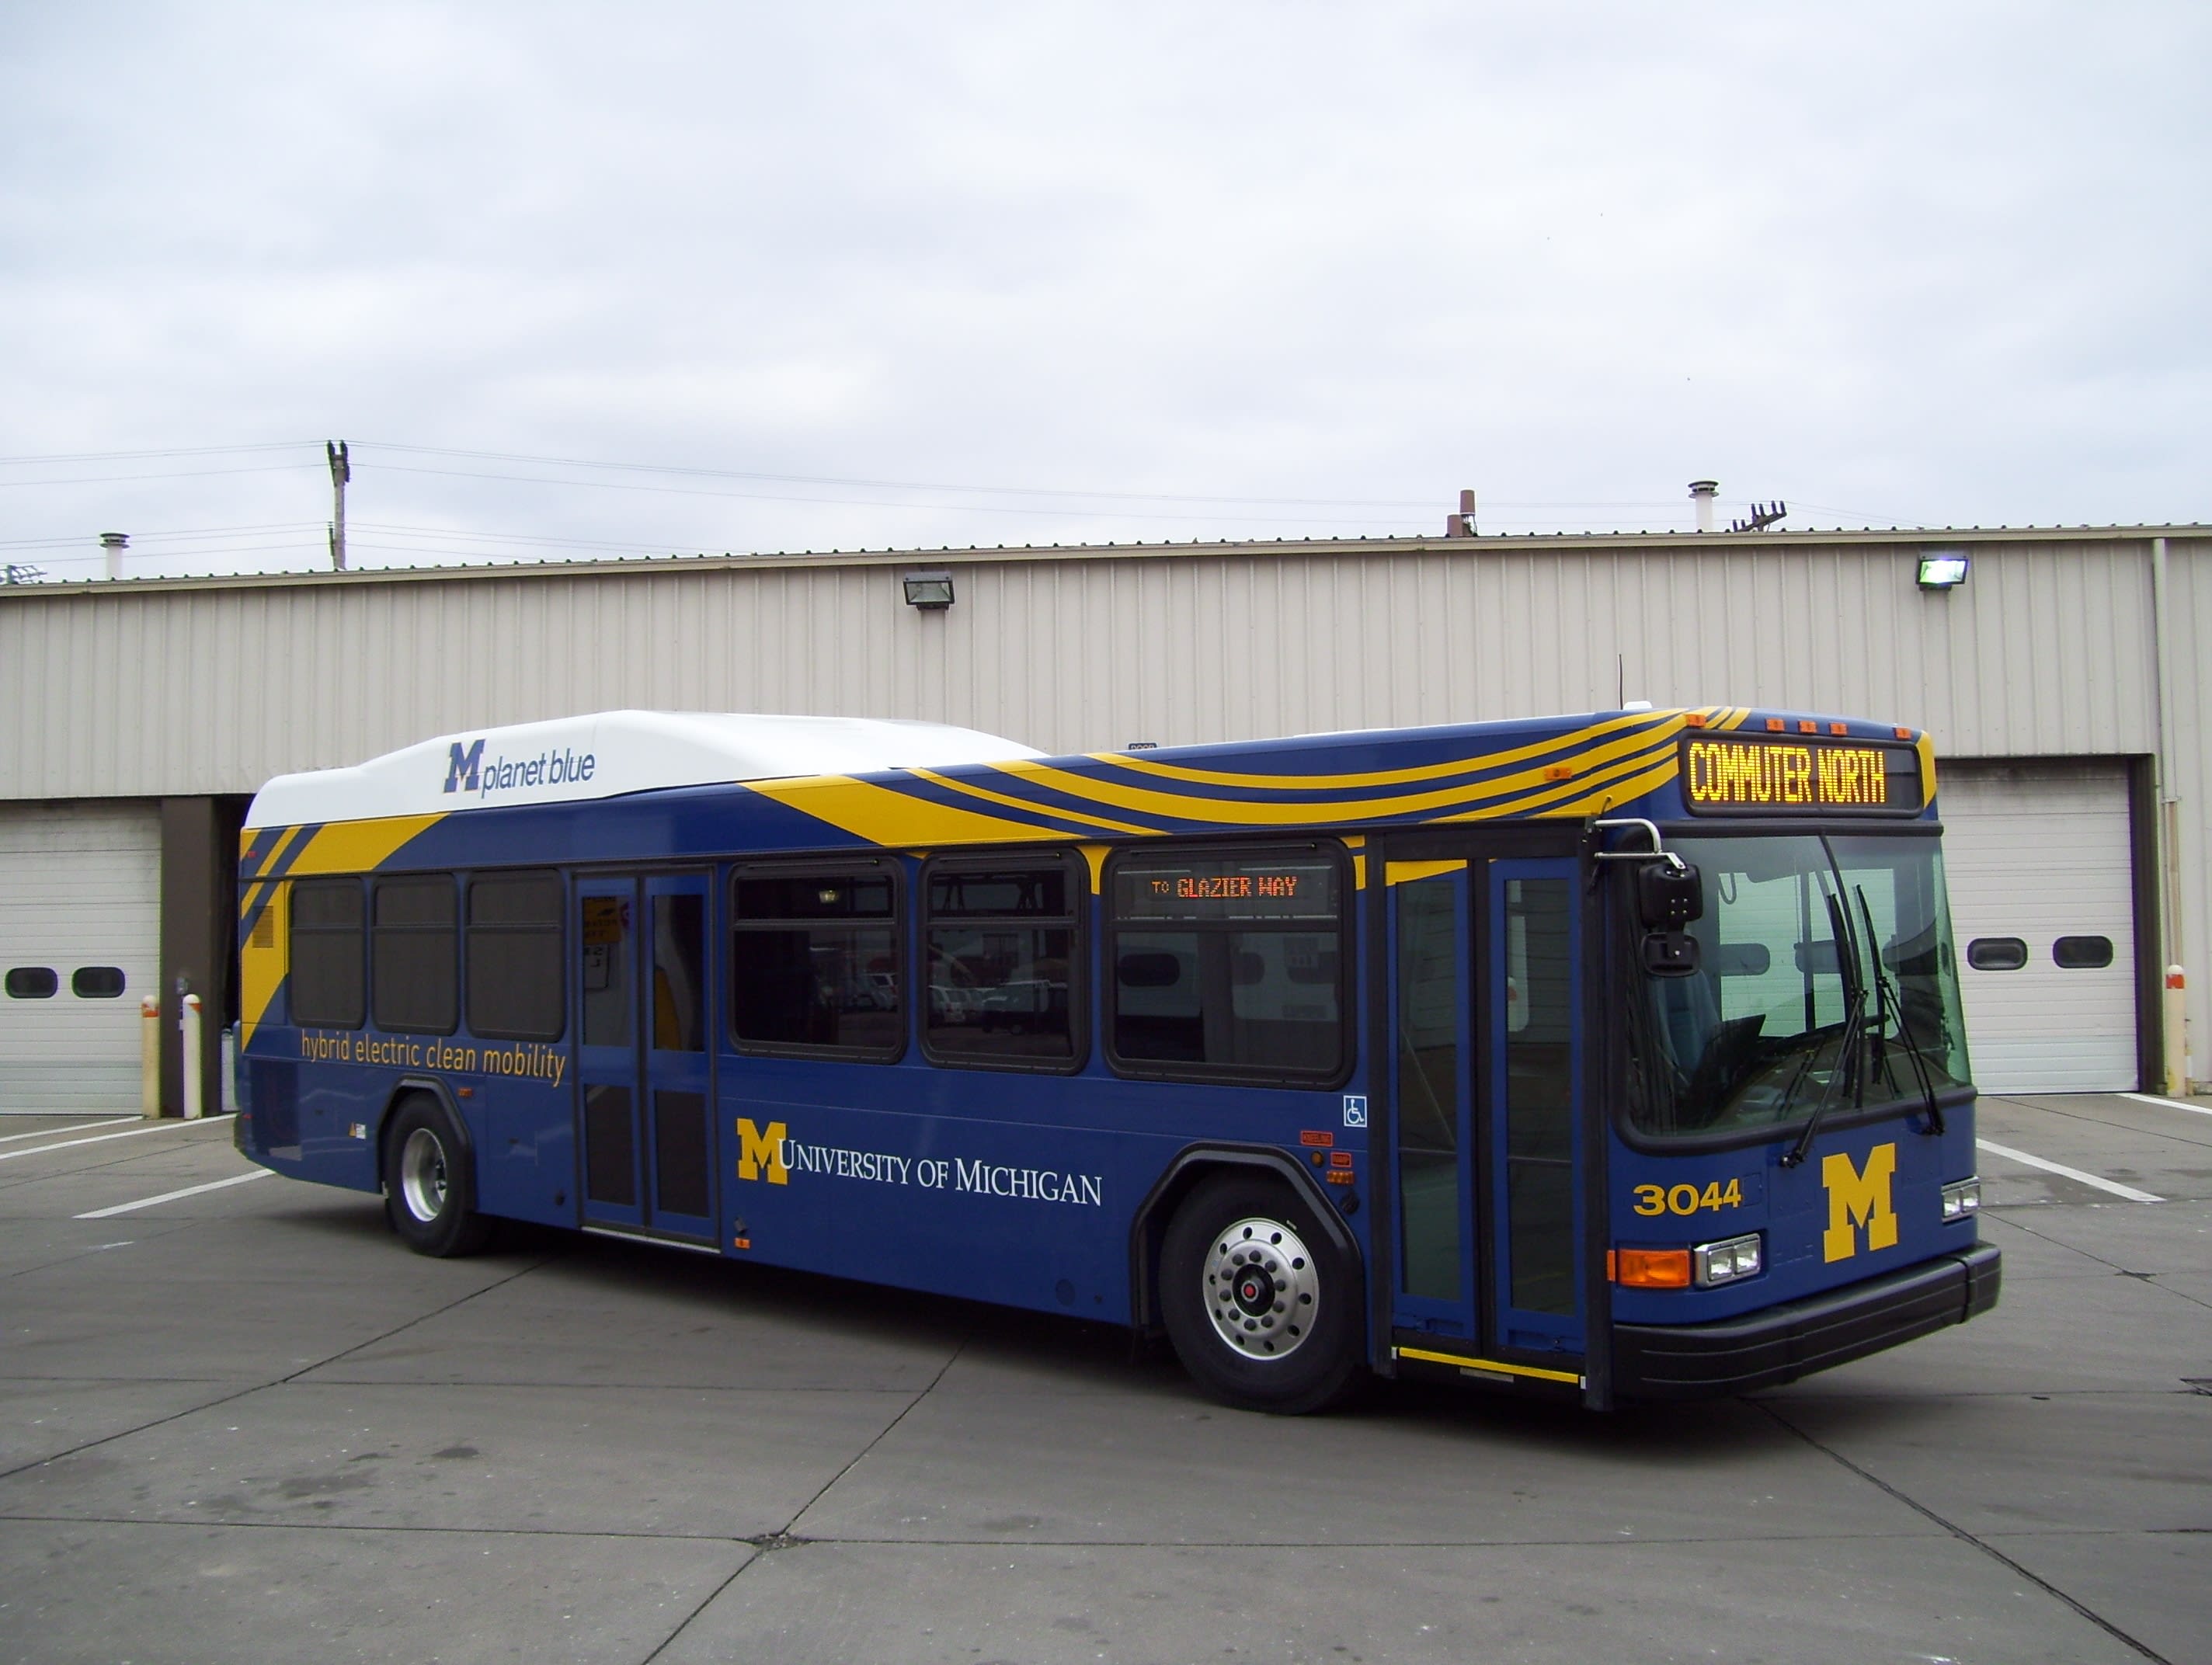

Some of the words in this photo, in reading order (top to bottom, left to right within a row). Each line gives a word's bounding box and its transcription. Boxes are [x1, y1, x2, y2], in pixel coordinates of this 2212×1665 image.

[443, 739, 486, 794] M
[481, 750, 547, 800] planet
[548, 747, 596, 784] blue
[1689, 742, 1813, 802] COMMUTER
[1817, 748, 1886, 803] NORTH
[1177, 876, 1253, 899] GLAZIER
[1258, 875, 1299, 897] WAY
[301, 1028, 350, 1062] hybrid
[355, 1034, 421, 1067] electric
[426, 1038, 477, 1072] clean
[482, 1043, 567, 1088] mobility
[736, 1118, 788, 1186] M
[777, 1138, 912, 1185] UNIVERSITY
[916, 1159, 949, 1190] OF
[954, 1157, 1103, 1207] MICHIGAN
[1633, 1177, 1743, 1216] 3044
[1821, 1142, 1898, 1264] M
